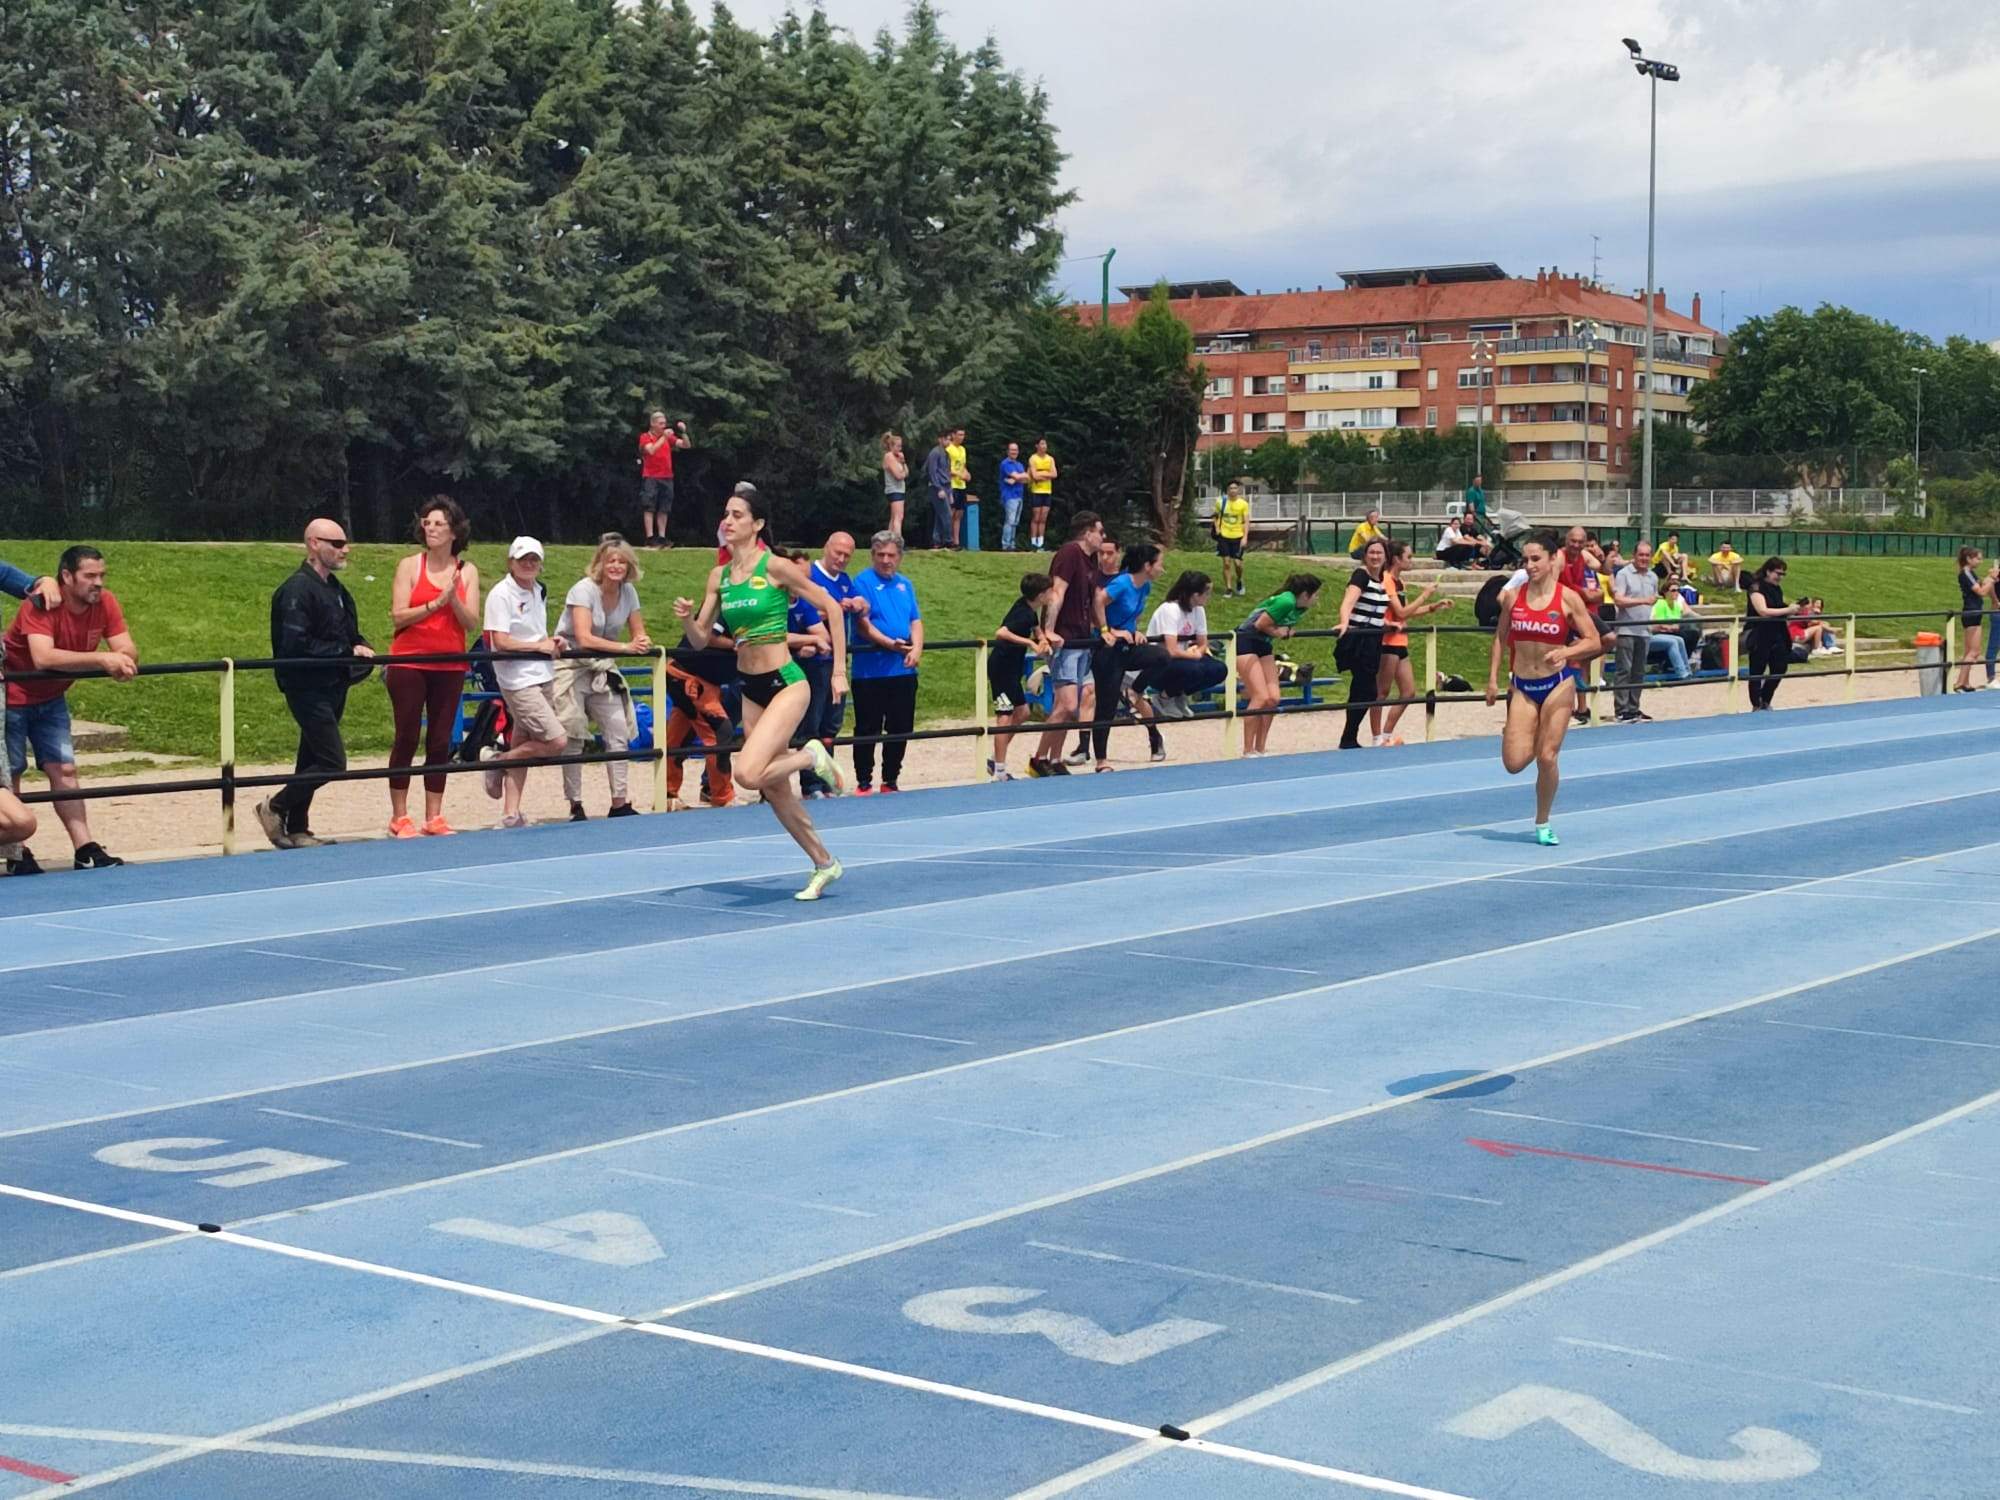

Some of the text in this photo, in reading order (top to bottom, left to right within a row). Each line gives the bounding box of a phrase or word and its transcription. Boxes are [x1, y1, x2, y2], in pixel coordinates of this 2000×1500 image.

[94, 1137, 346, 1188] 5
[430, 1210, 666, 1266] 4
[902, 1286, 1225, 1366] 3
[1440, 1382, 1822, 1485] 2
